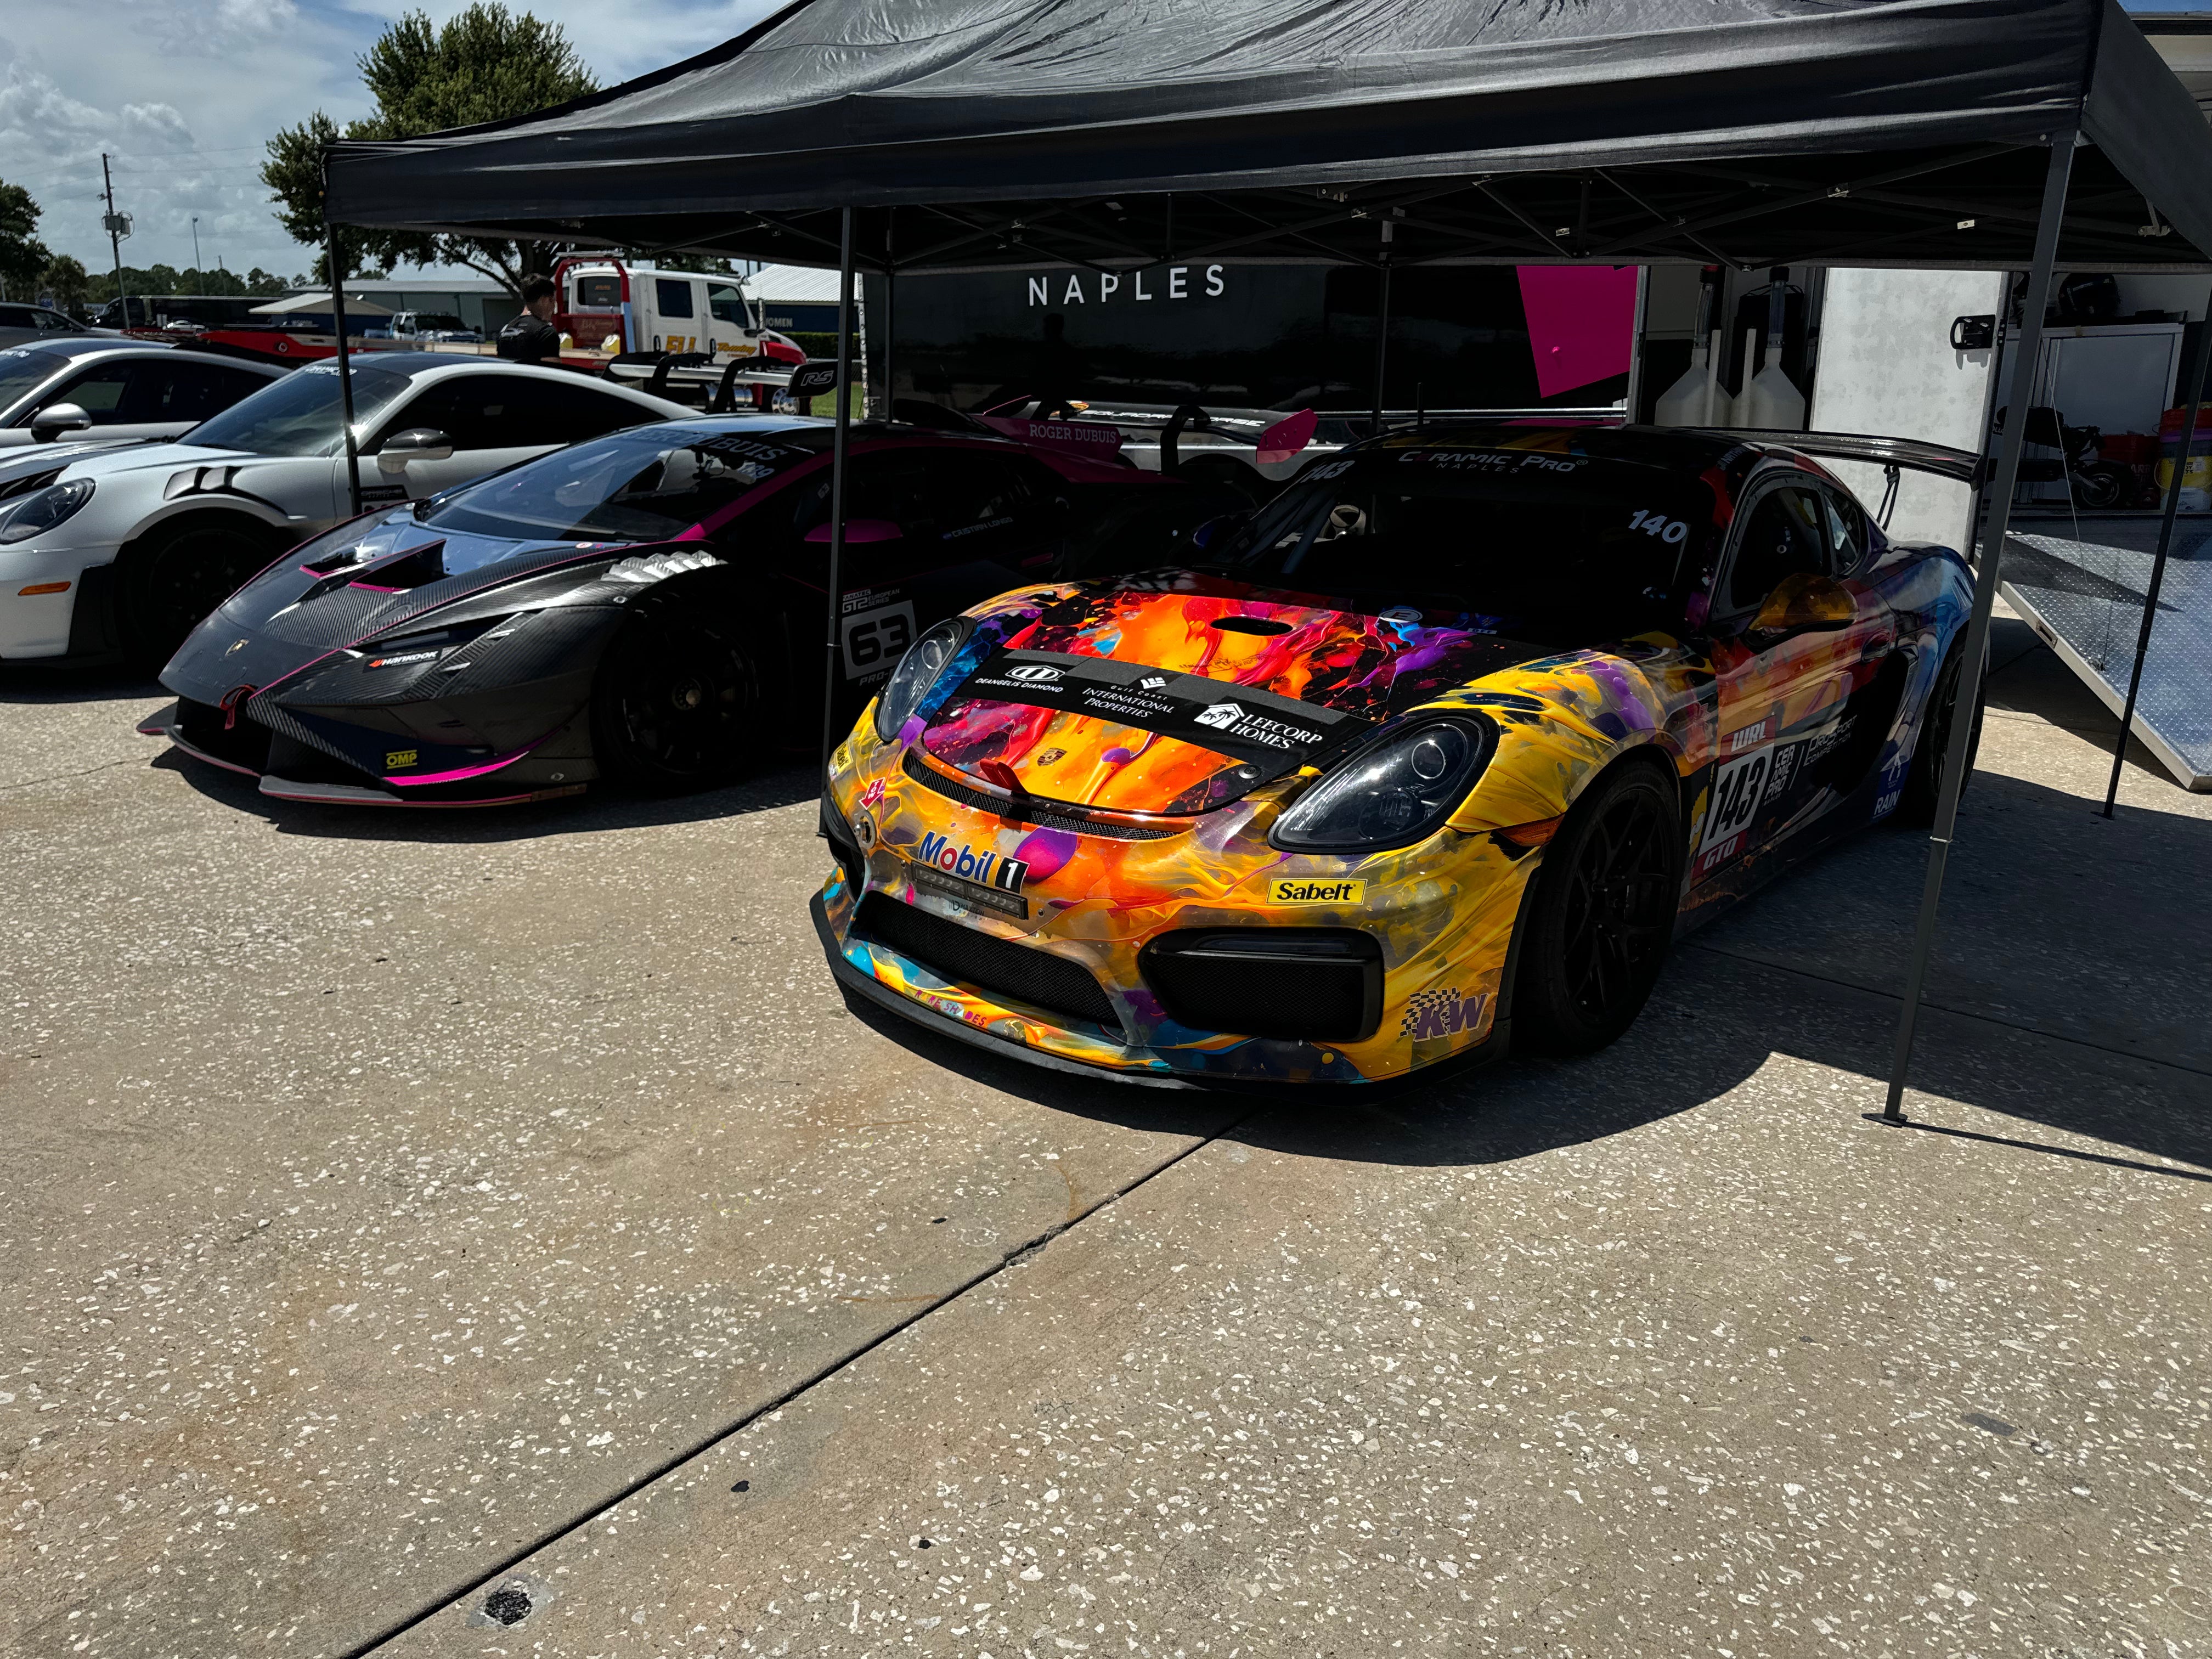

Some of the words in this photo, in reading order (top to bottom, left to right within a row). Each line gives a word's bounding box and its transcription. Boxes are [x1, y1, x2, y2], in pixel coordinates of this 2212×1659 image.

[1028, 264, 1224, 307] NAPLES
[800, 370, 834, 386] RS
[1029, 424, 1072, 441] ROGER
[1075, 428, 1116, 443] DUBUIS
[1436, 462, 1520, 473] NAPLES
[1628, 510, 1687, 543] 140
[842, 597, 868, 613] GT2
[868, 588, 900, 601] EUROPEAN
[868, 597, 890, 607] SERIES
[849, 614, 911, 666] 63
[975, 678, 1022, 686] DEANGELIS
[1021, 683, 1064, 692] DIAMOND
[1082, 687, 1175, 713] INTERNATIONAL
[1084, 697, 1153, 718] PROPERTIES
[1229, 723, 1295, 749] HOMES
[1241, 714, 1323, 744] LEECORP
[1731, 721, 1766, 752] WRL
[386, 753, 417, 766] OMP
[1775, 744, 1796, 769] CER
[868, 781, 880, 799] TOW
[1707, 756, 1766, 841] 143
[1764, 775, 1788, 799] PRO
[1874, 789, 1901, 816] RAIN
[918, 831, 996, 884] Mobil
[1702, 836, 1739, 871] GTO
[1276, 882, 1353, 900] Sabelt
[914, 989, 943, 1008] RARE
[943, 1002, 988, 1026] SHADES
[1414, 993, 1489, 1042] KW
